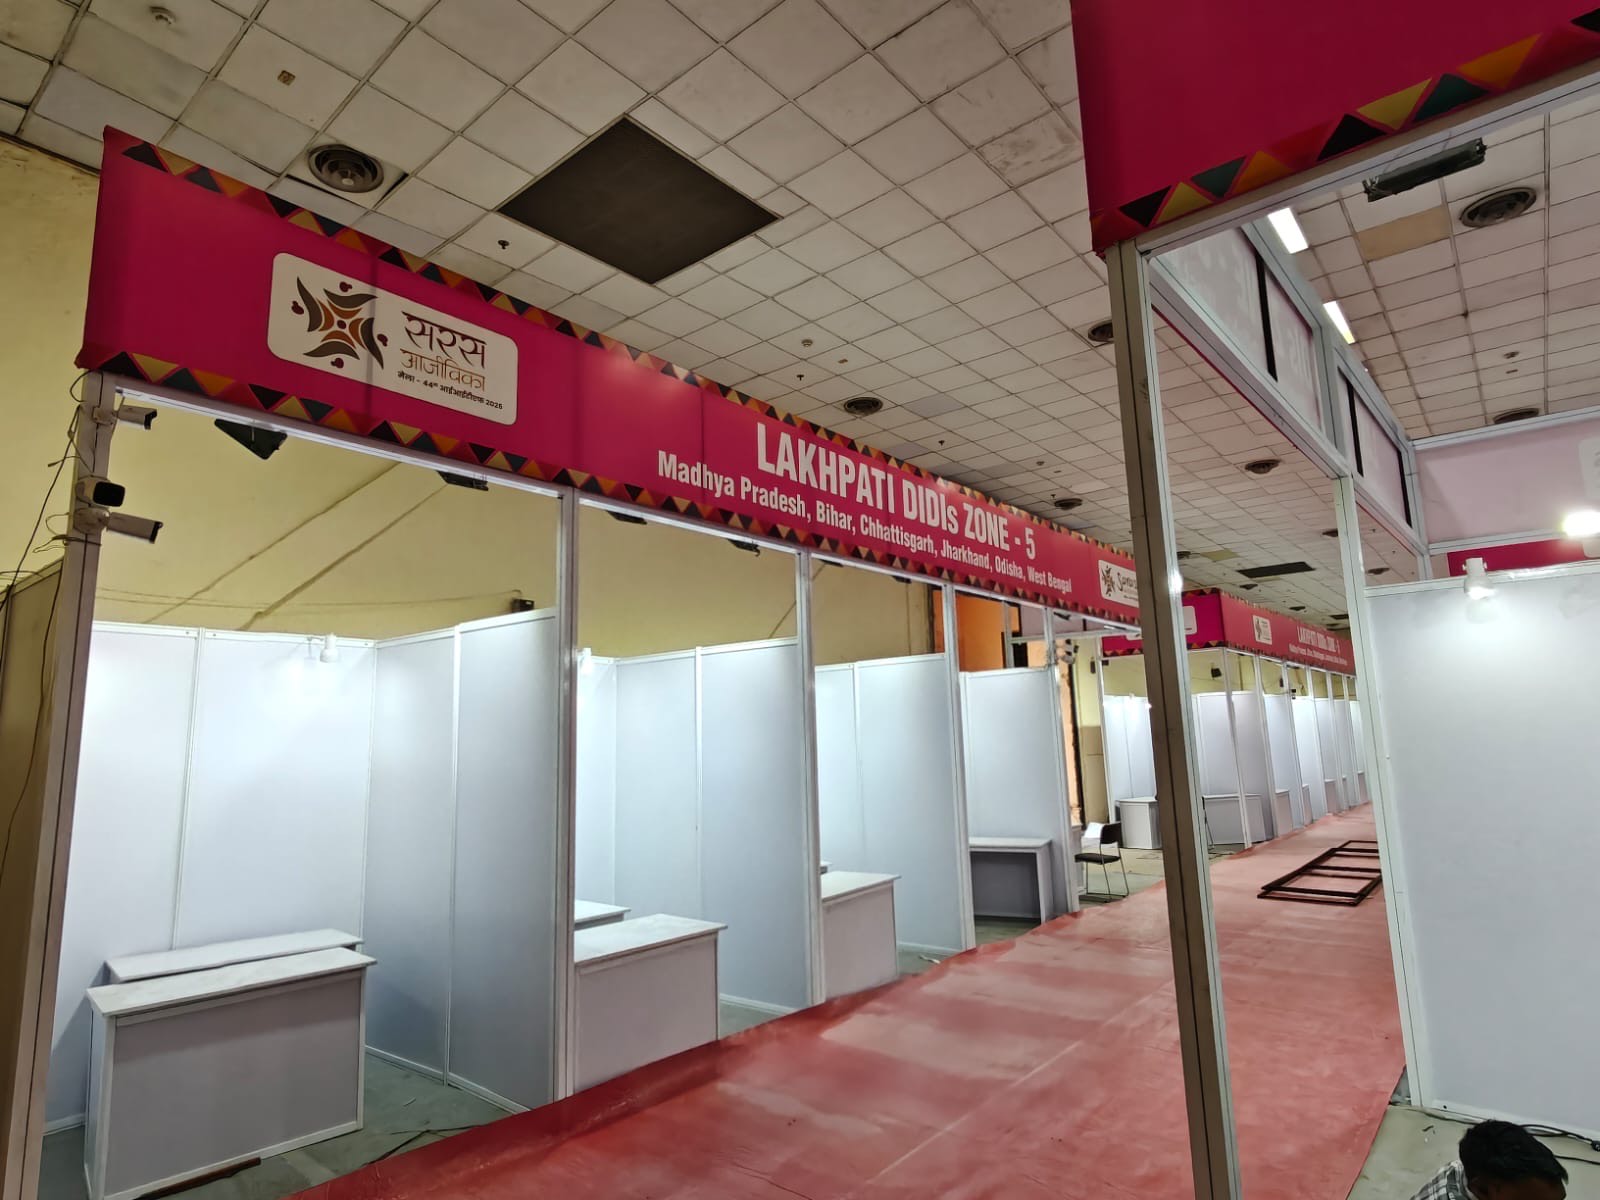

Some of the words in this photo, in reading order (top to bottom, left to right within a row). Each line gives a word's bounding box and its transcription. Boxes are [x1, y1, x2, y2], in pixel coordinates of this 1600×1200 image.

[399, 348, 486, 392] आजीविका
[401, 310, 488, 369] सरस
[658, 450, 735, 498] Madhya
[740, 476, 812, 523] Pradesh,
[816, 500, 856, 535] Bihar,
[860, 514, 938, 558] Chhattisgarh,
[941, 539, 993, 573] Jharkhand,
[995, 555, 1026, 582] Odisha,
[1027, 566, 1046, 586] West
[1047, 572, 1072, 594] Bengal
[757, 422, 895, 514] LAKHPATI
[902, 478, 959, 535] DIDIs
[963, 502, 1010, 552] ZONE
[1025, 527, 1036, 560] 5
